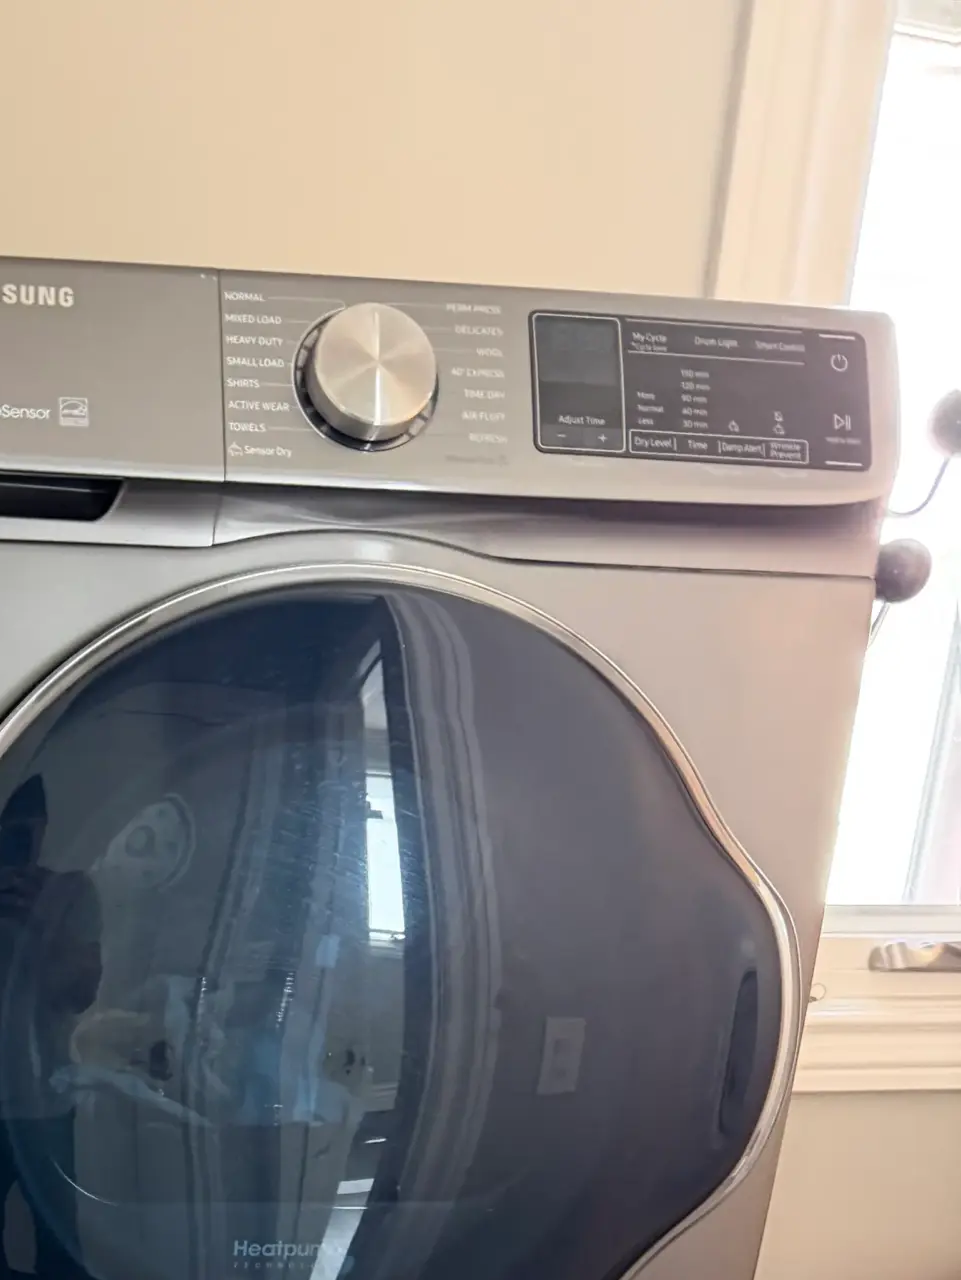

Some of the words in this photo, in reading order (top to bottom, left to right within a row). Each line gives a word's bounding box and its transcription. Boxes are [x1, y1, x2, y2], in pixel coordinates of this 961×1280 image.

[224, 291, 266, 302] NORMAL
[225, 313, 255, 324] MIXED
[257, 315, 282, 325] LOAD
[455, 325, 504, 337] DELICATES
[226, 336, 256, 345] HEAVY
[258, 336, 283, 347] DUTY
[226, 357, 258, 368] SMALL
[259, 358, 284, 368] LOAD
[227, 378, 261, 389] SHIRTS
[228, 400, 261, 411] ACTIVE
[262, 402, 290, 412] WEAR
[559, 414, 584, 425] Adjust
[585, 415, 606, 425] Time
[228, 422, 267, 432] TOWELS
[634, 436, 649, 448] Dry
[650, 437, 672, 448] Level
[688, 439, 708, 450] Time
[244, 445, 275, 456] Sensor
[276, 446, 292, 459] Dry
[232, 1240, 339, 1260] Heatpu
